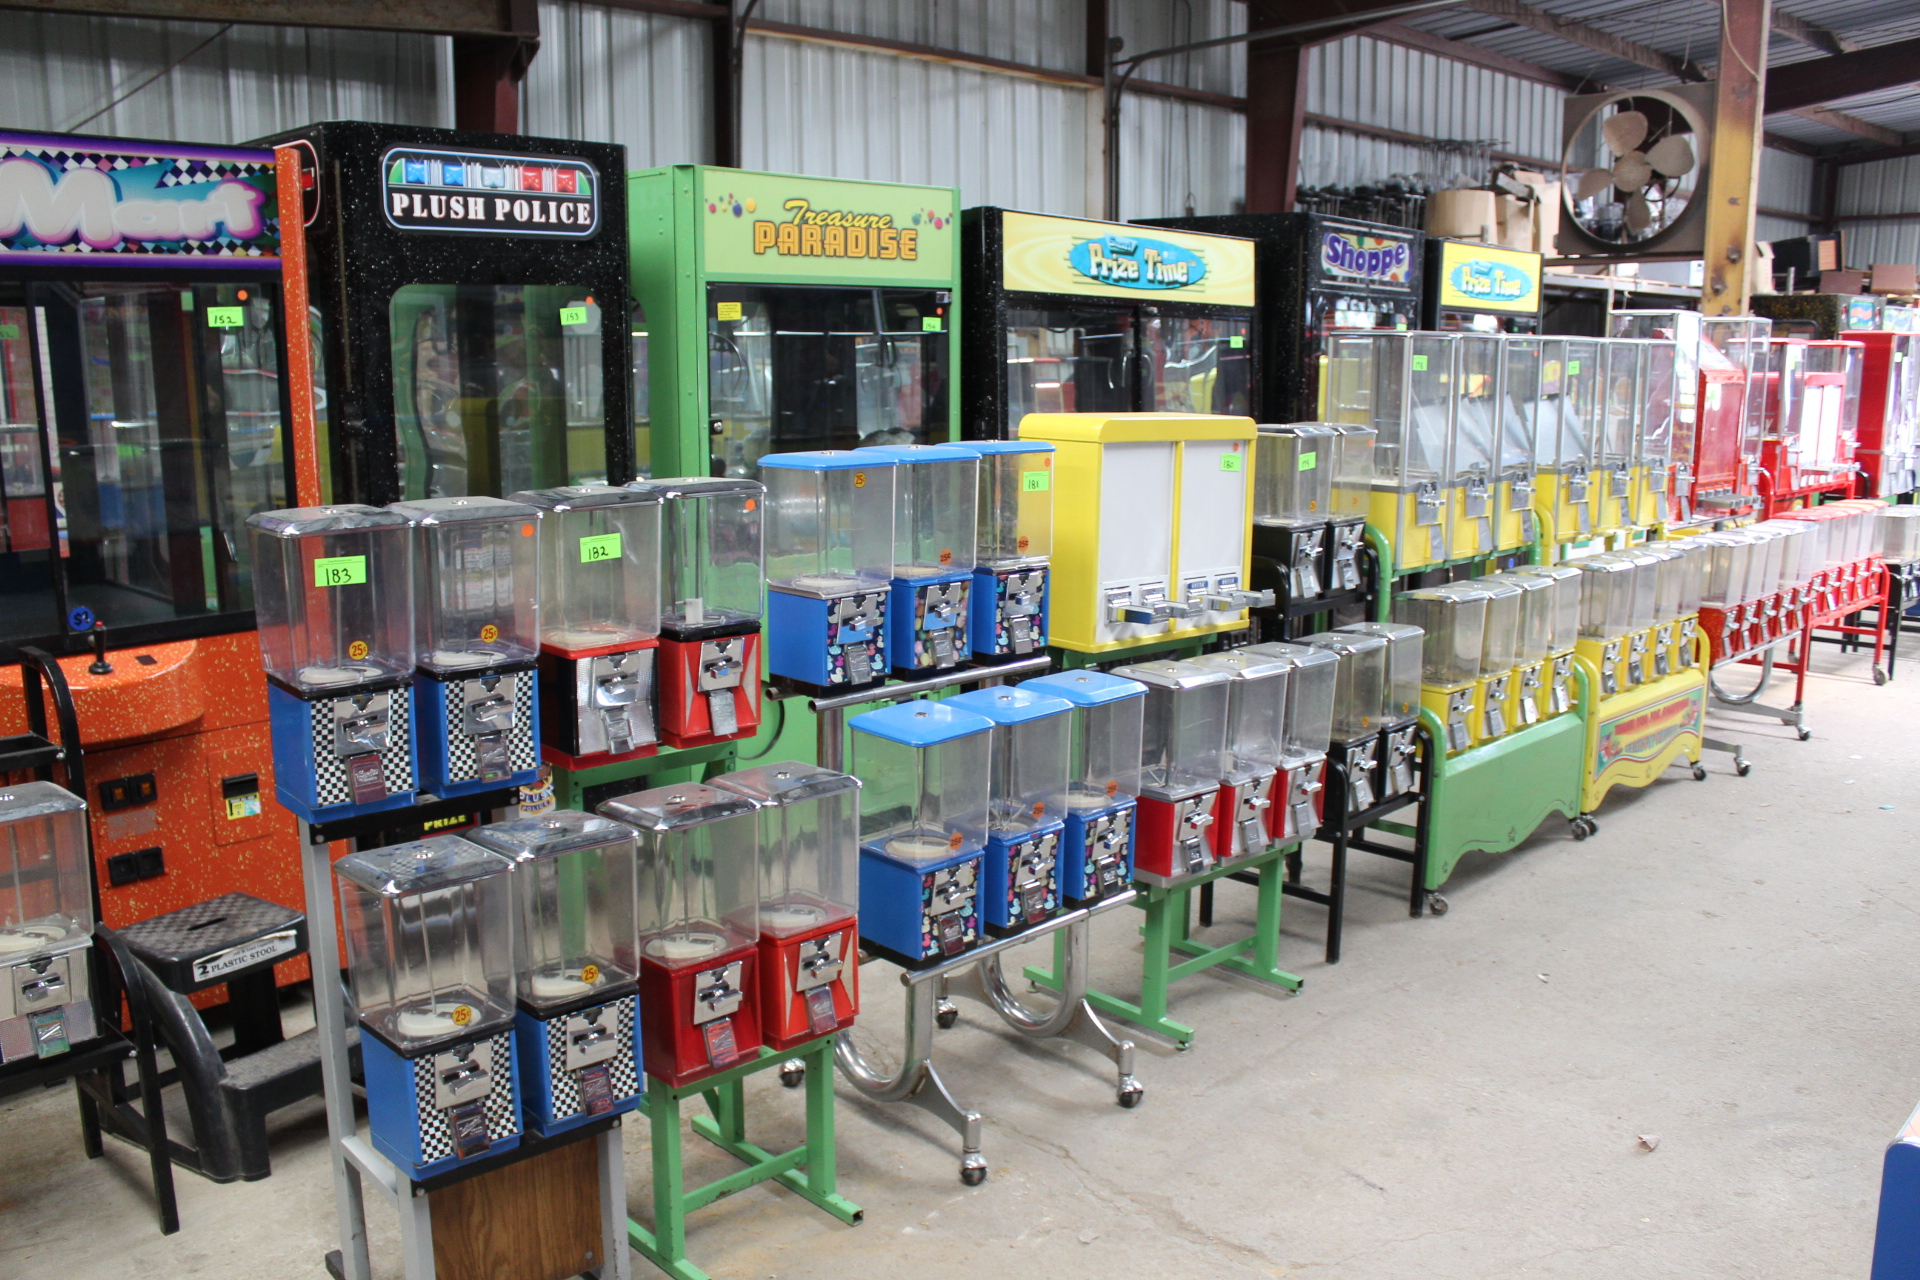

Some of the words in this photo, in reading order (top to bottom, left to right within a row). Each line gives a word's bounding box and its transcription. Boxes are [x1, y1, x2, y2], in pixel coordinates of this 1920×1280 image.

[0, 156, 265, 249] Mart
[391, 192, 485, 220] PLUSH
[494, 198, 591, 225] POLICE
[783, 198, 893, 229] Treasure
[753, 220, 918, 260] PARADISE
[1087, 241, 1140, 282] Prize
[1143, 247, 1190, 285] Time
[1325, 233, 1406, 278] Shoppe
[1461, 265, 1492, 295] Prize
[1494, 269, 1522, 297] Time
[213, 314, 238, 325] 152
[566, 312, 580, 322] 153
[1223, 459, 1235, 469] 180
[1028, 479, 1040, 490] 181
[588, 545, 609, 560] 182
[325, 567, 352, 586] 183
[482, 627, 497, 639] 25¢
[351, 643, 367, 656] 25¢
[197, 964, 210, 976] 2
[211, 955, 248, 973] PLASTIC
[250, 945, 277, 961] STOOL
[583, 969, 598, 981] 25¢
[454, 1009, 470, 1022] 25¢
